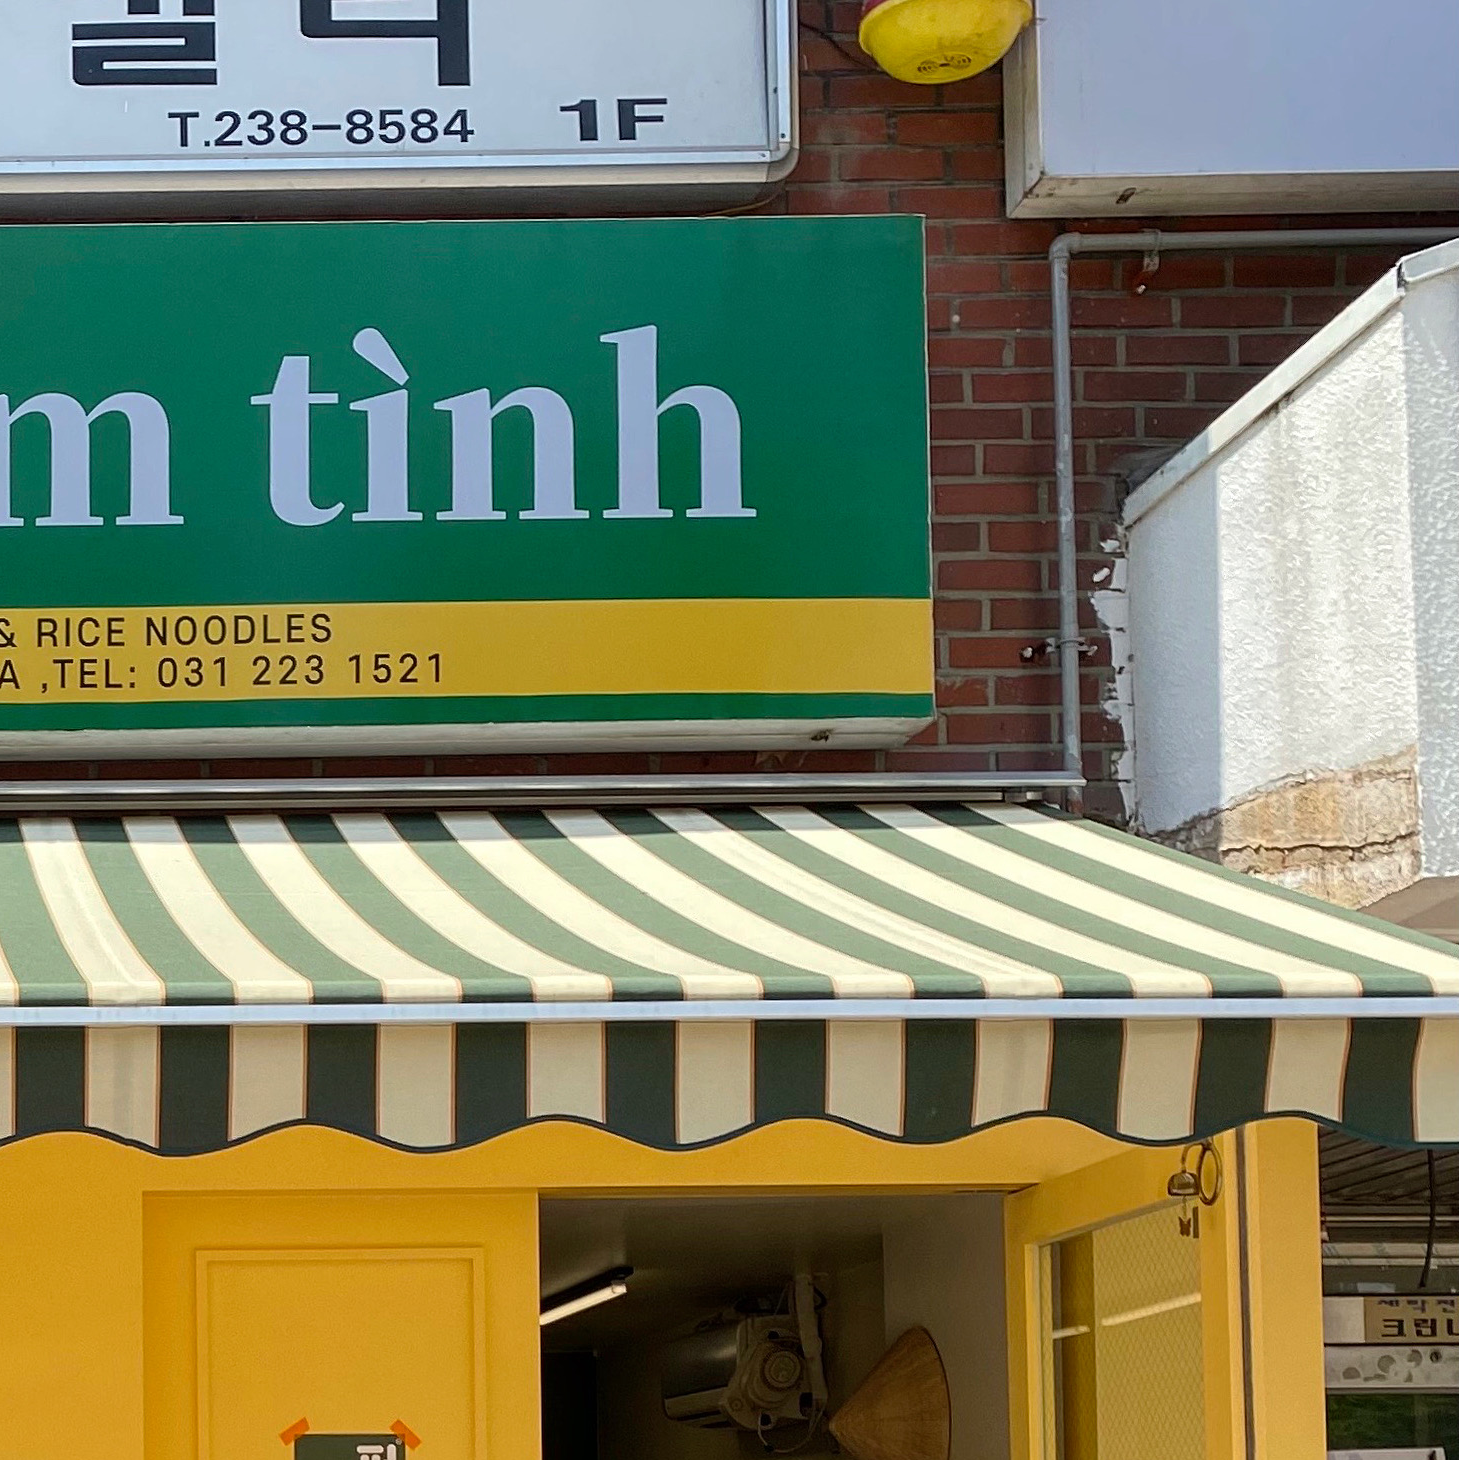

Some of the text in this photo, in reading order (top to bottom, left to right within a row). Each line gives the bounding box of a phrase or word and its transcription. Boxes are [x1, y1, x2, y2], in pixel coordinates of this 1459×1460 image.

[167, 98, 668, 148] T.238-8584 1F
[250, 325, 757, 527] tình
[35, 616, 127, 648] RICE
[145, 613, 333, 646] NOODLES
[157, 655, 229, 690] 031
[251, 654, 327, 688] 223
[348, 653, 447, 686] 1521
